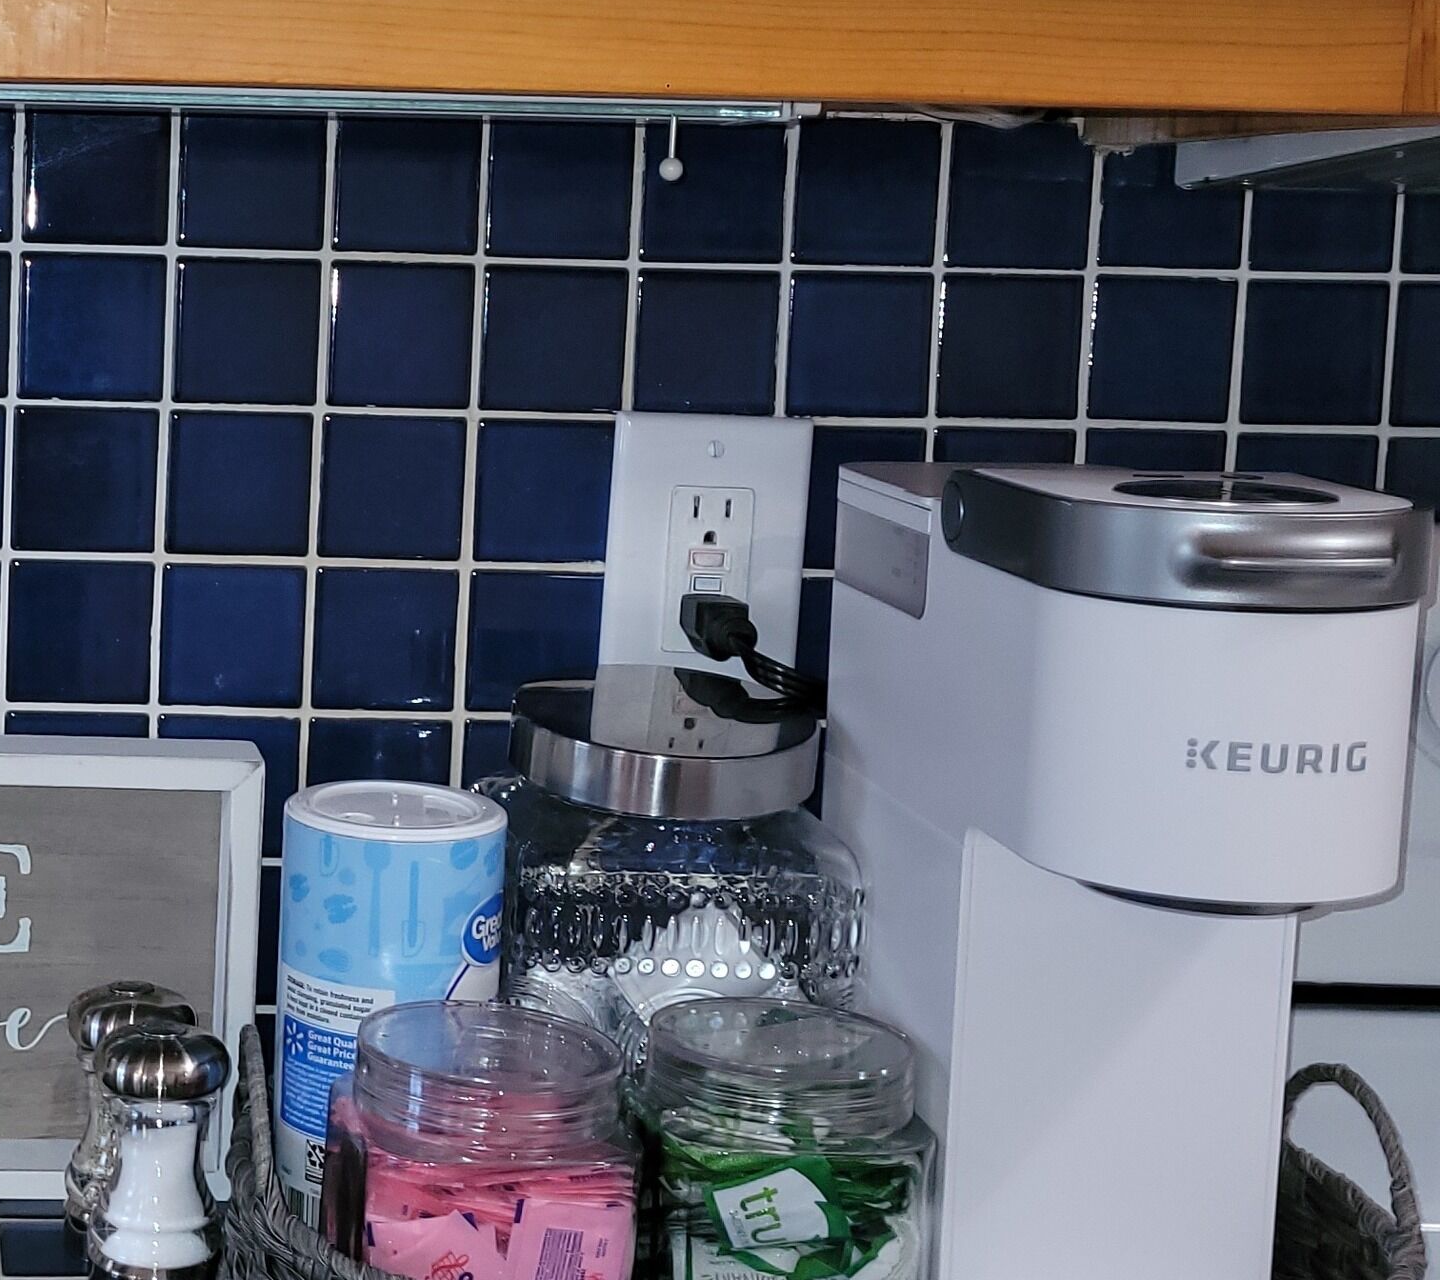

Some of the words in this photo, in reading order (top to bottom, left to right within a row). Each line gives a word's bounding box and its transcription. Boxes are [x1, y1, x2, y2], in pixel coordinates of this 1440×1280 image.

[1185, 737, 1368, 774] KEURIG
[472, 912, 502, 939] Grea
[308, 1030, 332, 1045] Great
[333, 1037, 357, 1050] Qual
[308, 1041, 332, 1055] Great
[307, 1051, 355, 1071] Guarantee
[740, 1186, 787, 1244] tru
